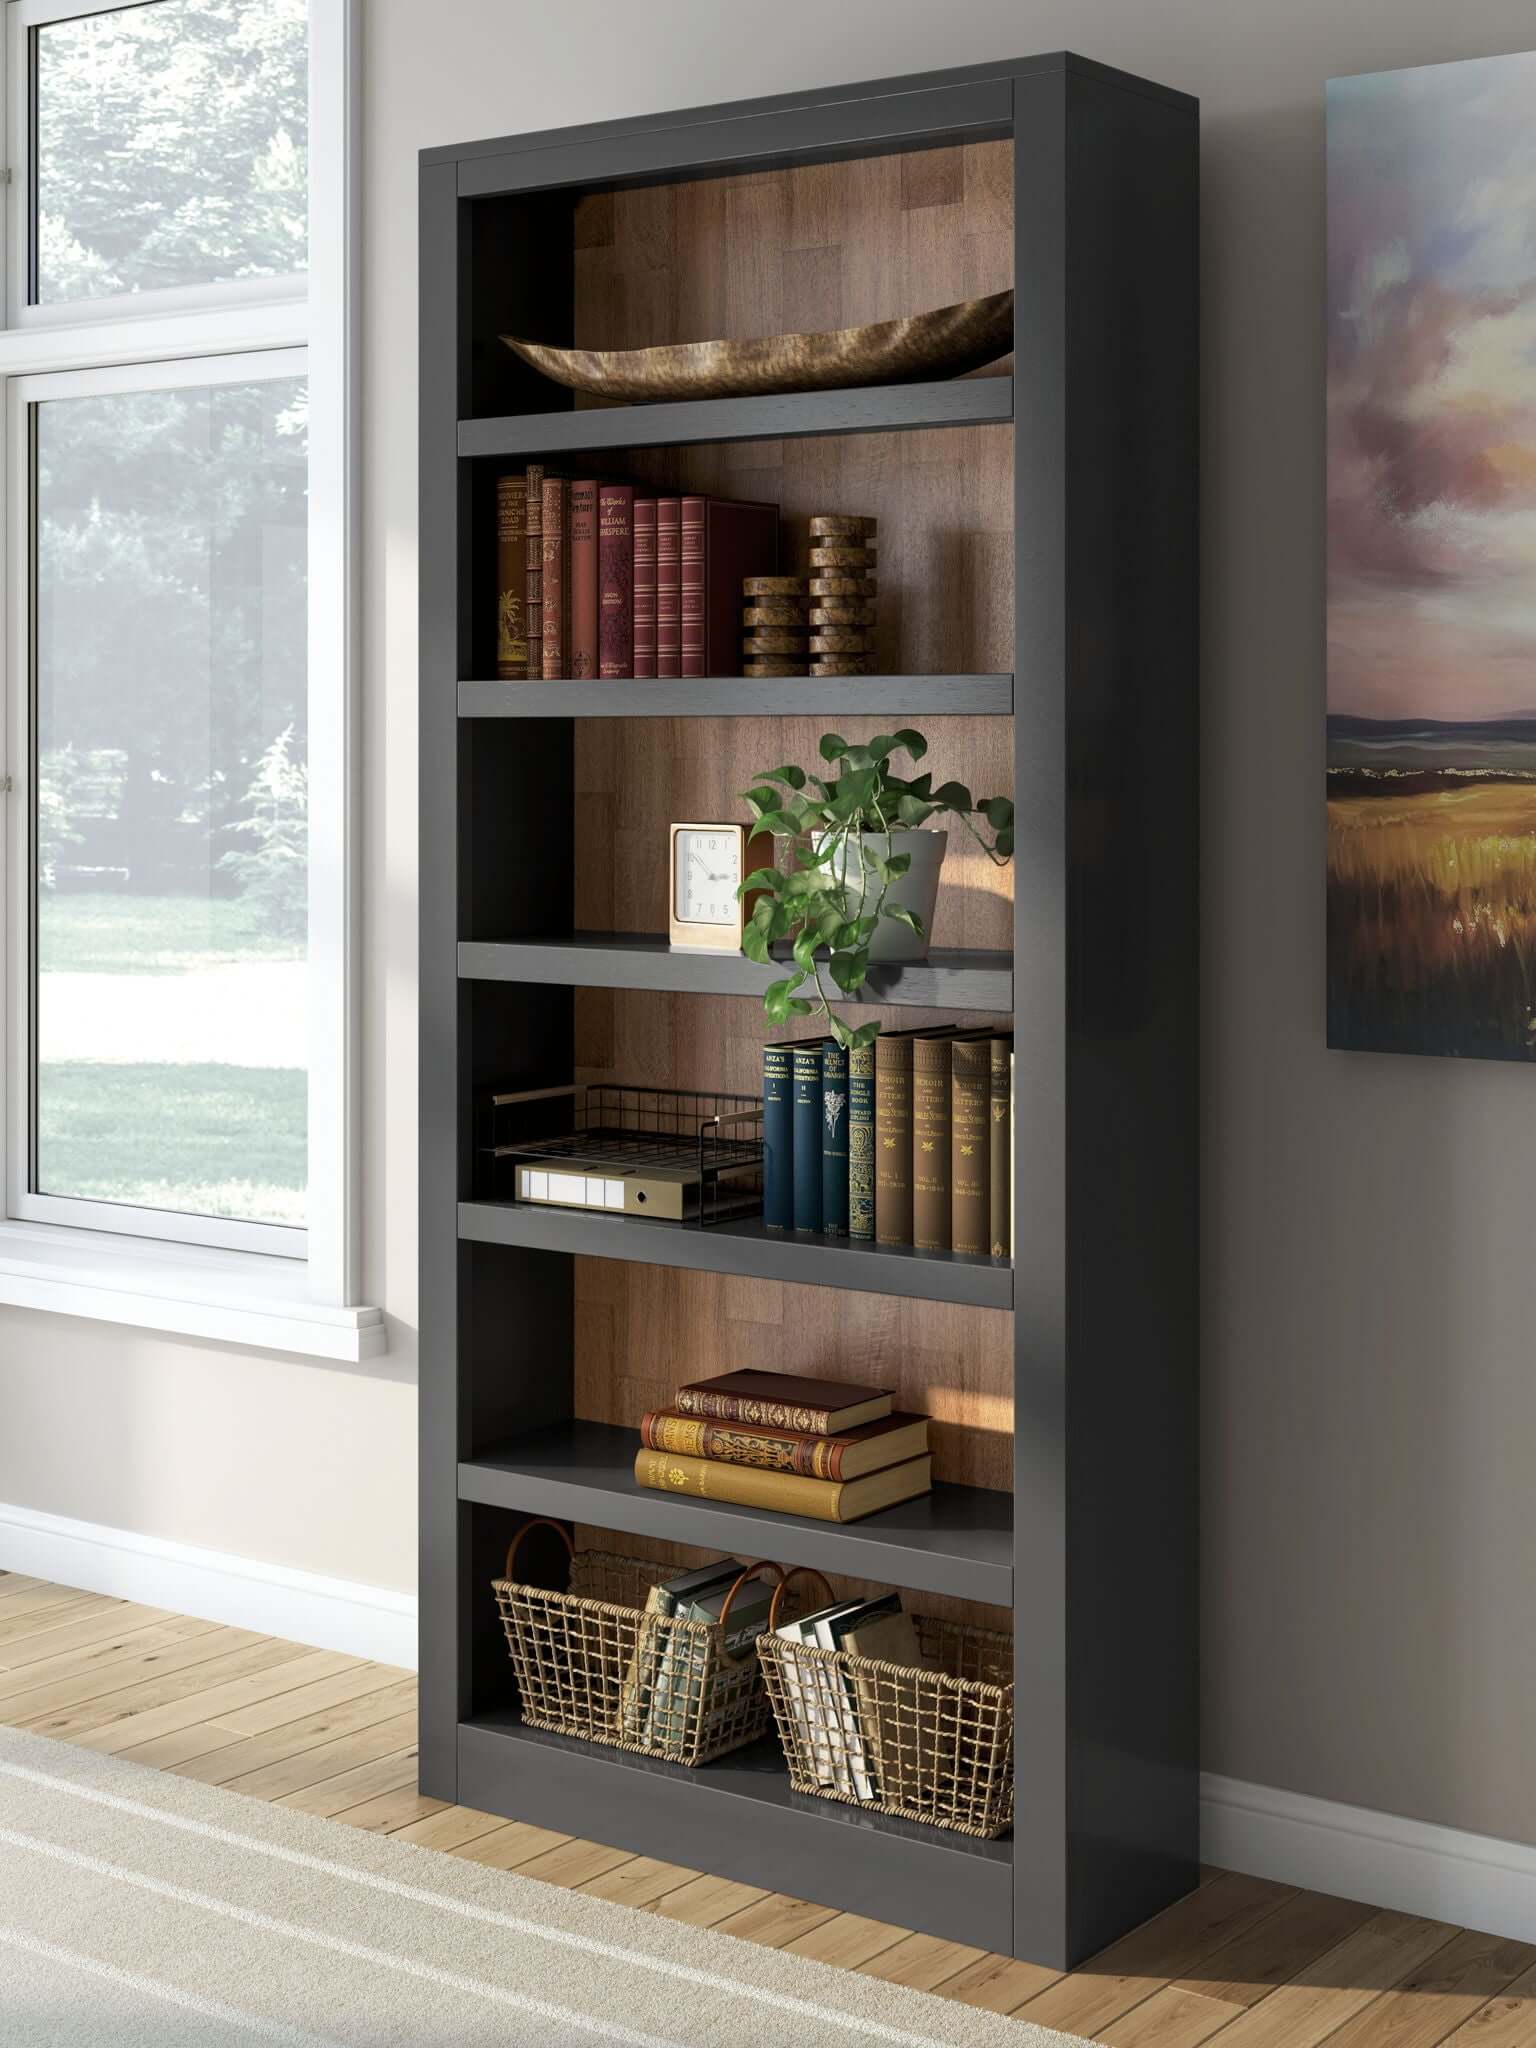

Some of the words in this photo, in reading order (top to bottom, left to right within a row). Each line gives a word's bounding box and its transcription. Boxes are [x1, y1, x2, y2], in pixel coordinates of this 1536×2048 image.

[696, 839, 702, 849] 11
[708, 839, 718, 850] 12
[687, 888, 693, 899] 8
[696, 903, 702, 913] 7
[710, 904, 715, 914] 6
[723, 904, 729, 914] 5
